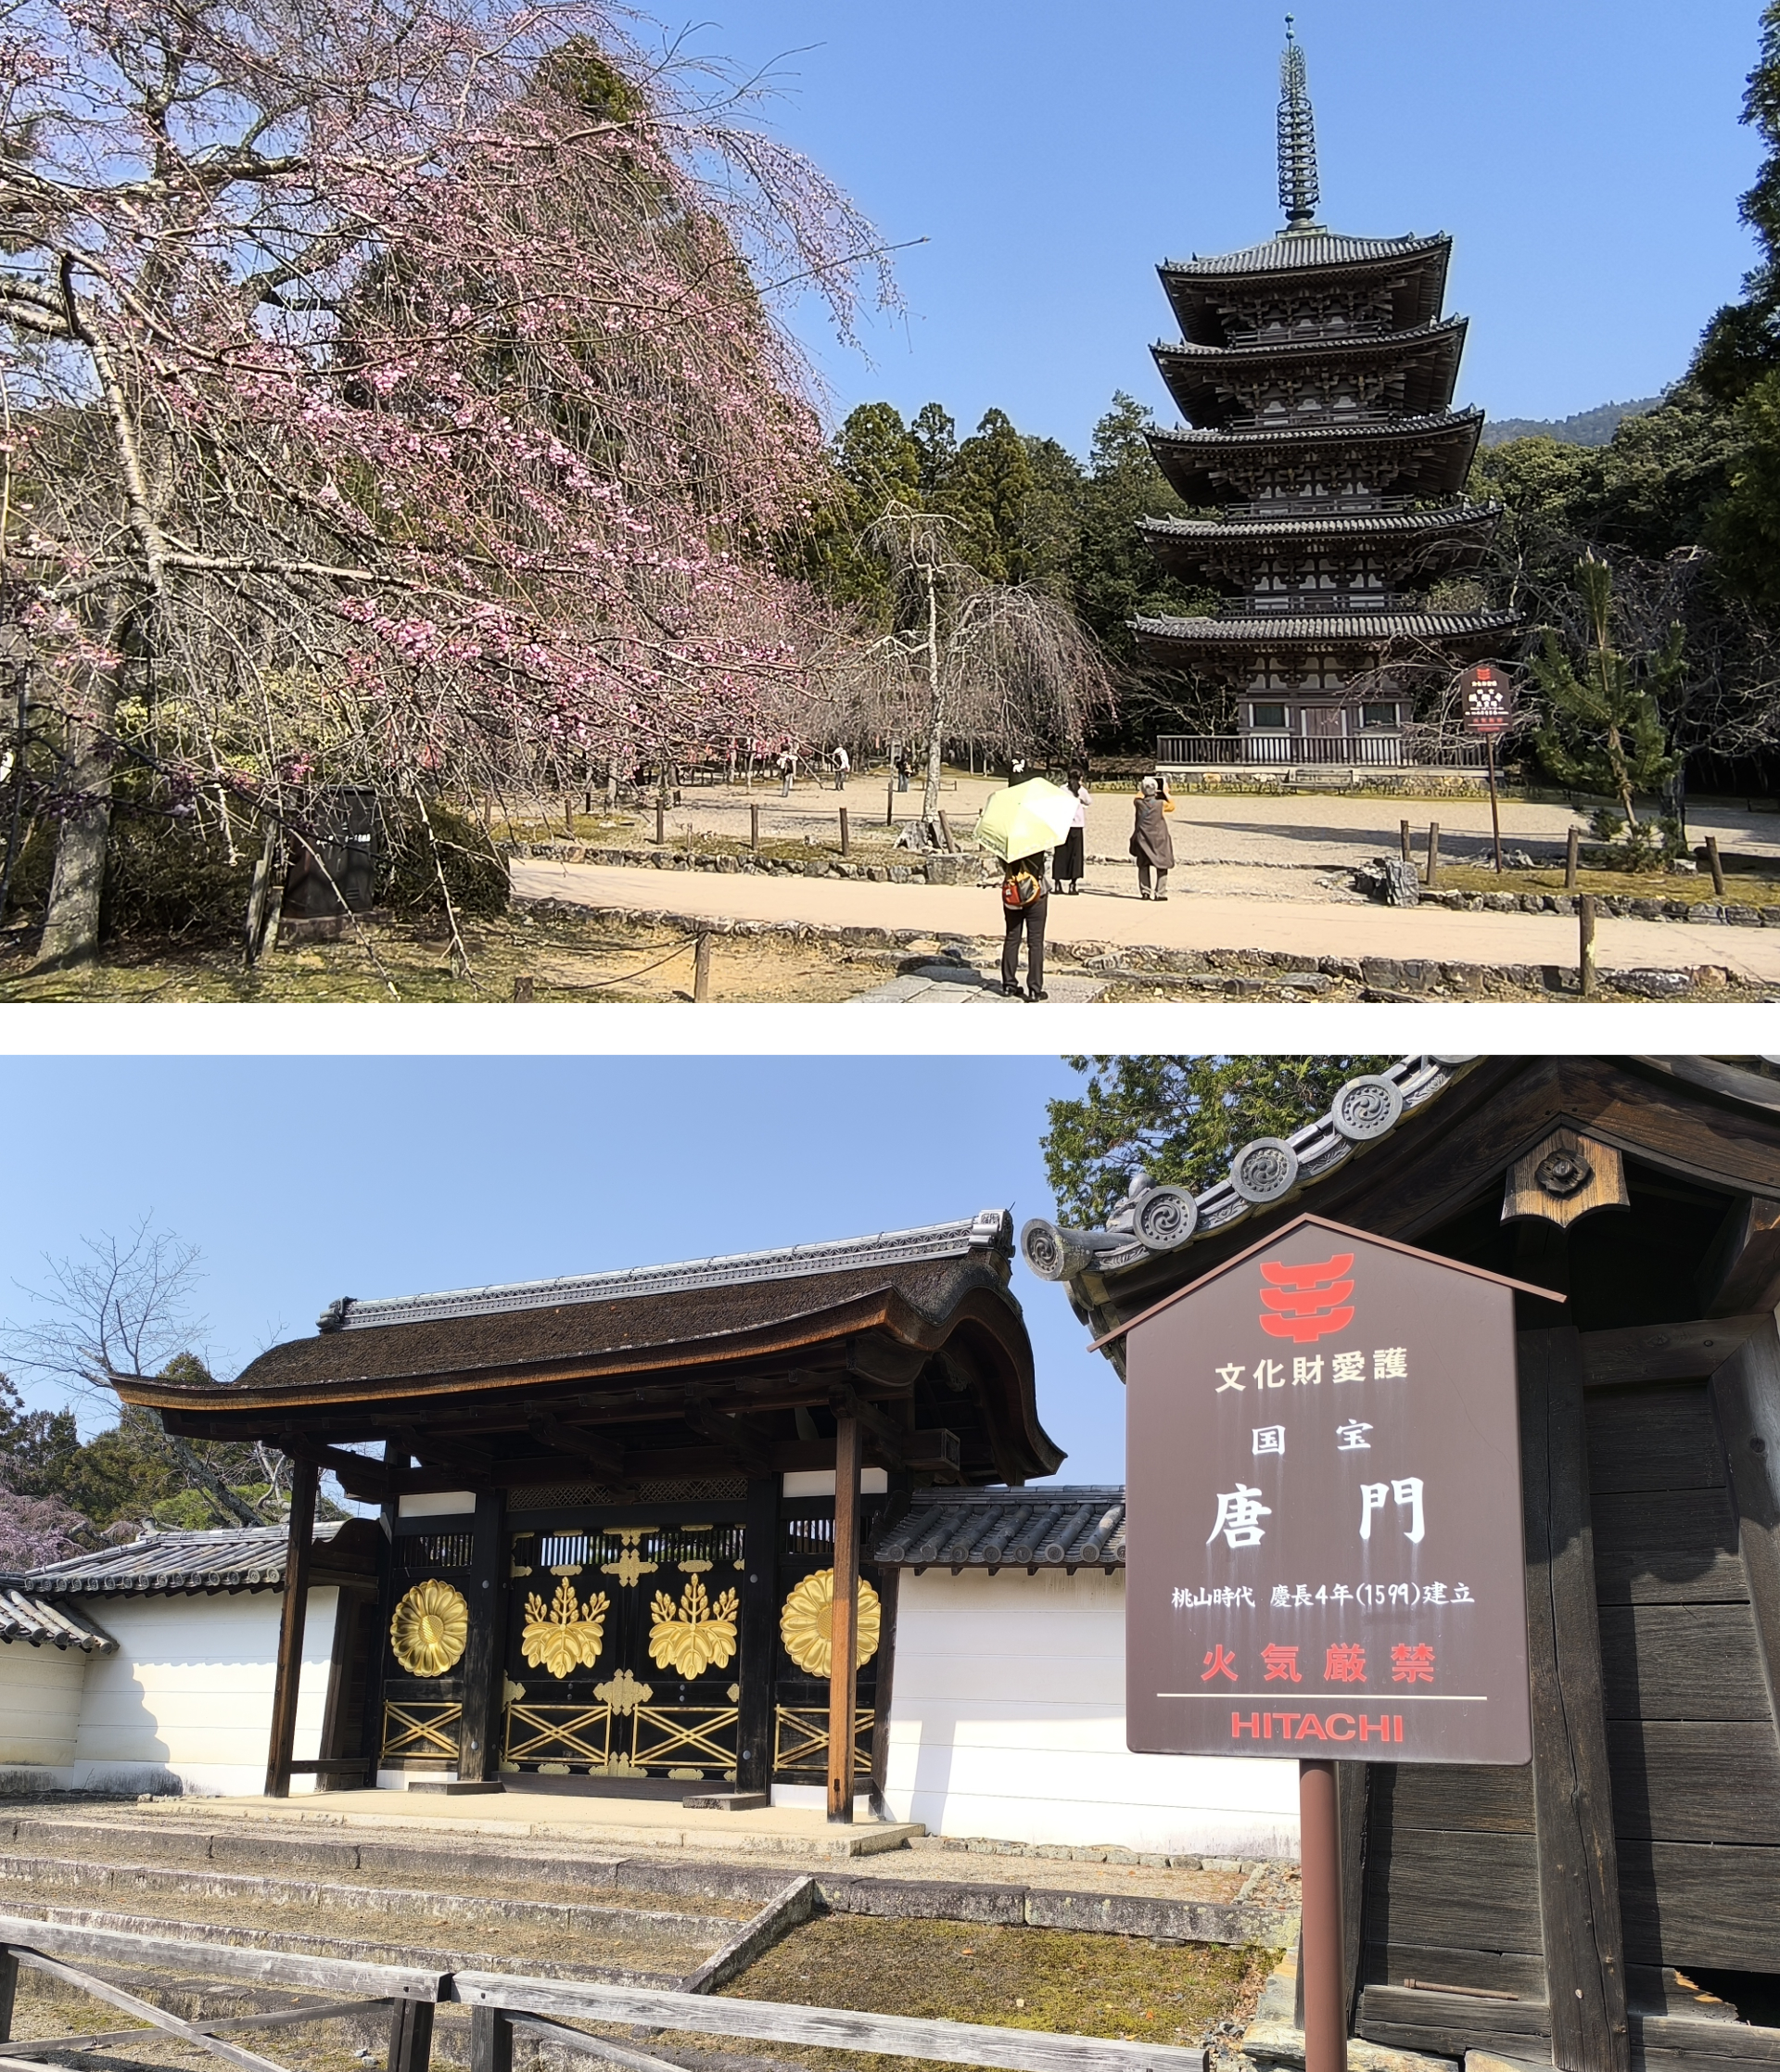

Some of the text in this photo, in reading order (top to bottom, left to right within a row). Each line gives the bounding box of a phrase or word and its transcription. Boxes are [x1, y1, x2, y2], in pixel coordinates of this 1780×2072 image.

[1215, 1347, 1409, 1393] 文化財愛護
[1252, 1419, 1374, 1456] 国宝
[1206, 1477, 1427, 1549] 唐門
[1172, 1586, 1256, 1608] 桃山時代
[1201, 1644, 1436, 1684] 火気厳禁
[1231, 1712, 1405, 1743] HITACHI
